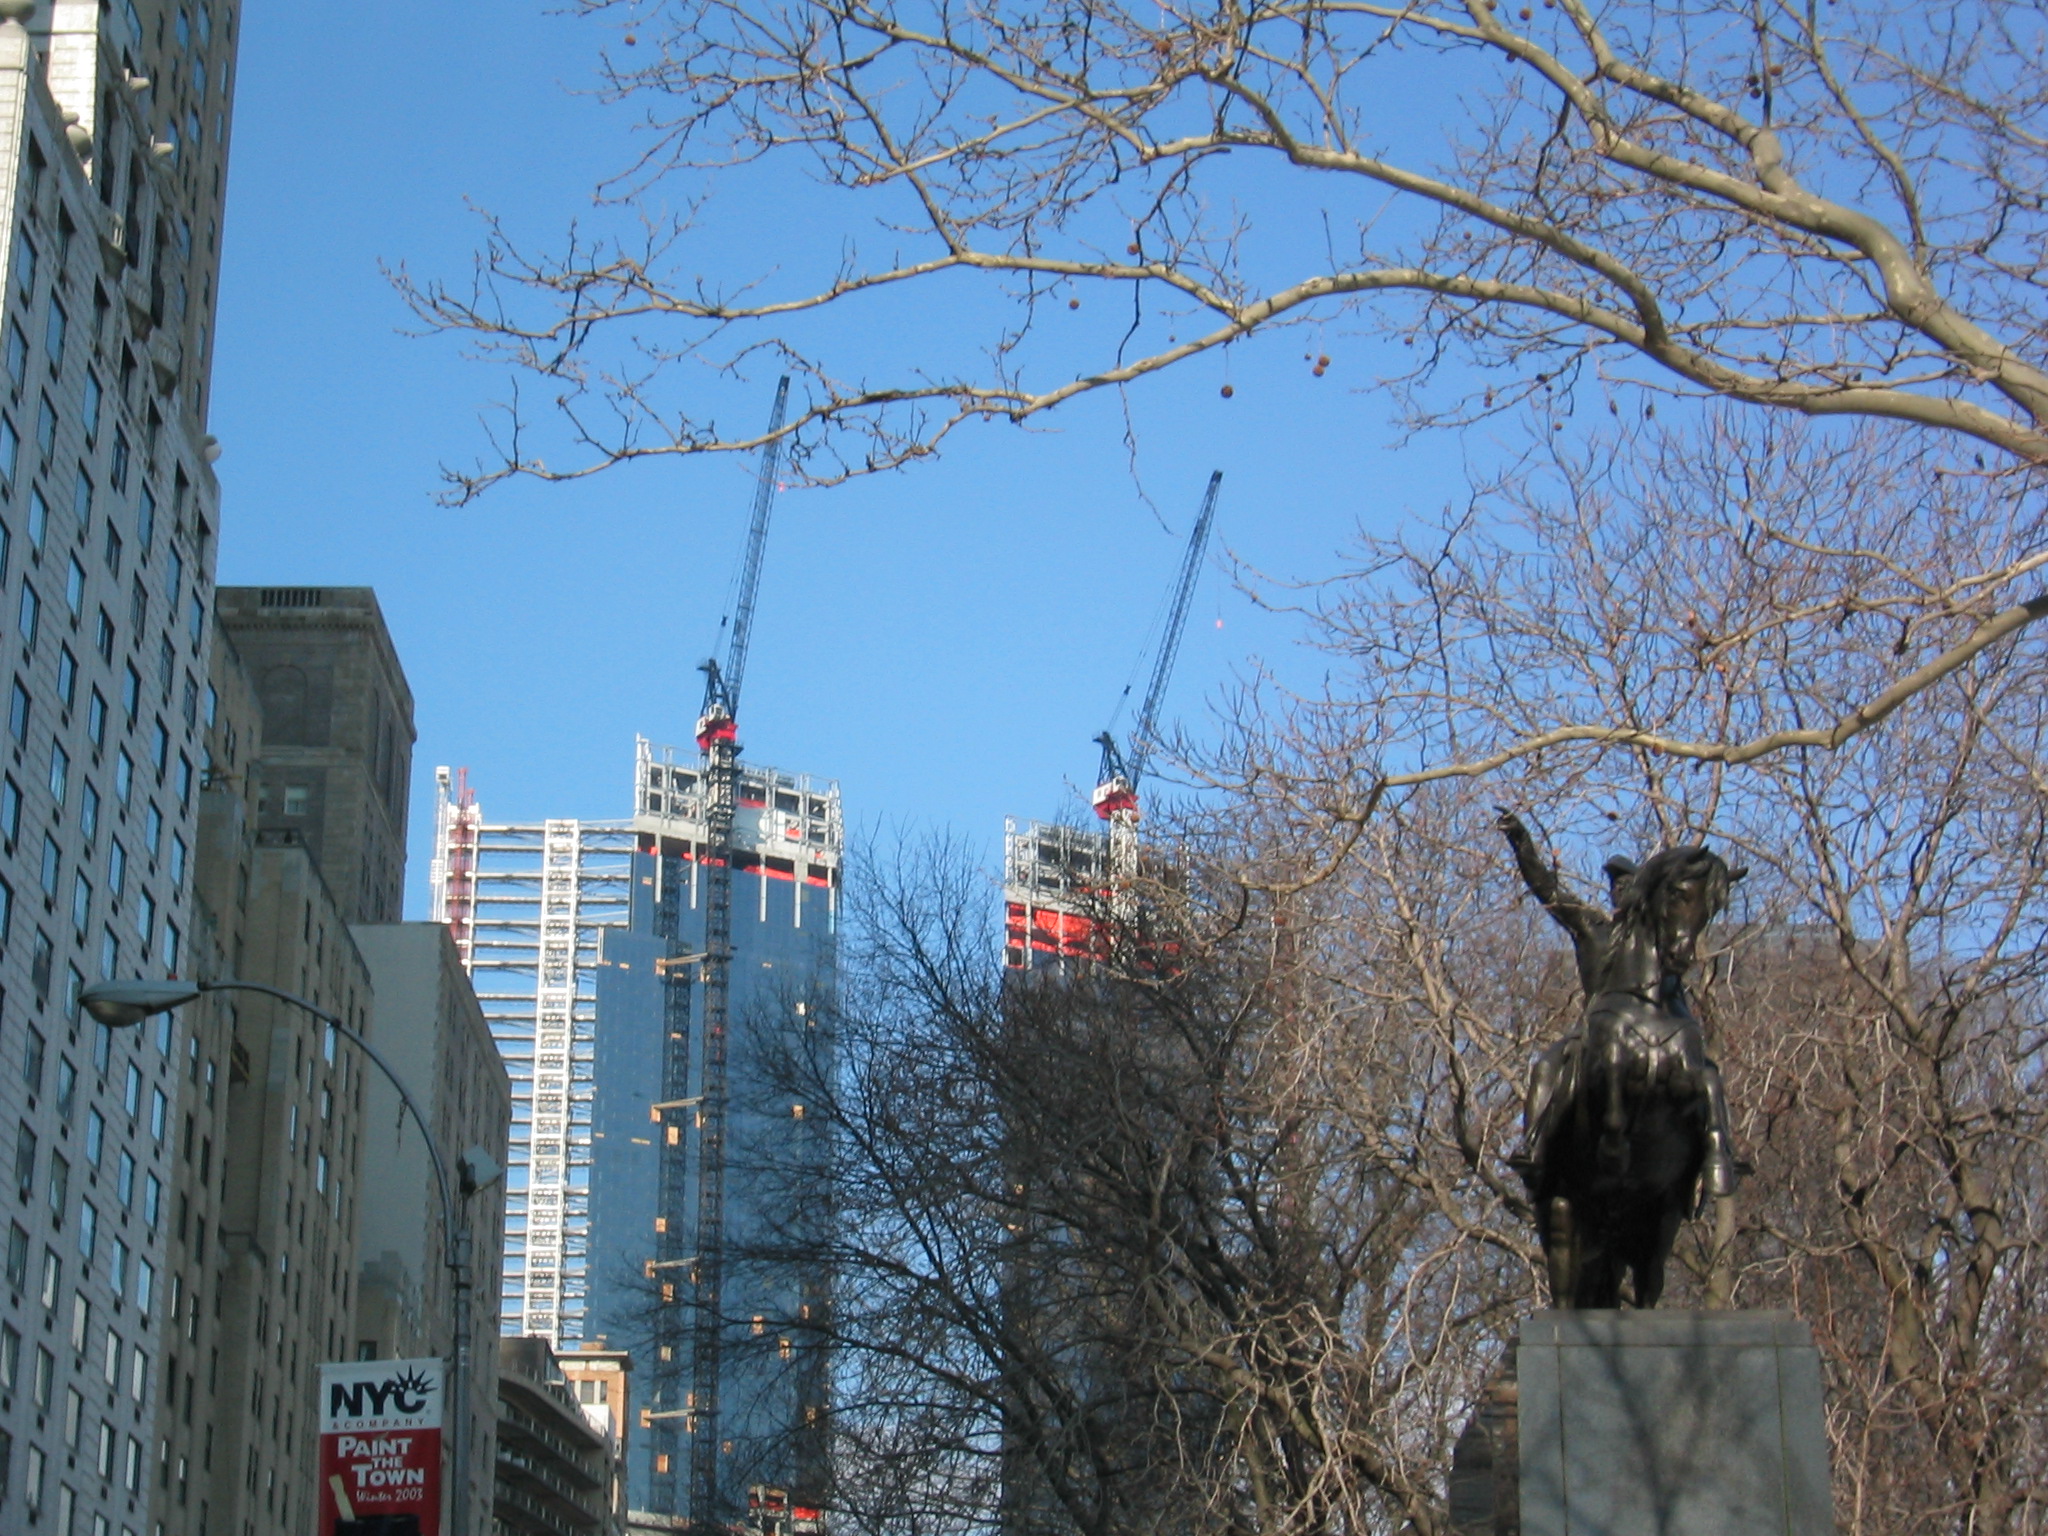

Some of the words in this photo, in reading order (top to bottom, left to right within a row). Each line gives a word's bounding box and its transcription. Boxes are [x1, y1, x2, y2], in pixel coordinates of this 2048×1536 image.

[330, 1372, 432, 1418] NYC
[337, 1436, 412, 1458] PAINT
[372, 1456, 403, 1469] THE
[351, 1463, 424, 1487] TOWN
[356, 1490, 392, 1502] Winter
[395, 1487, 424, 1502] 2003
